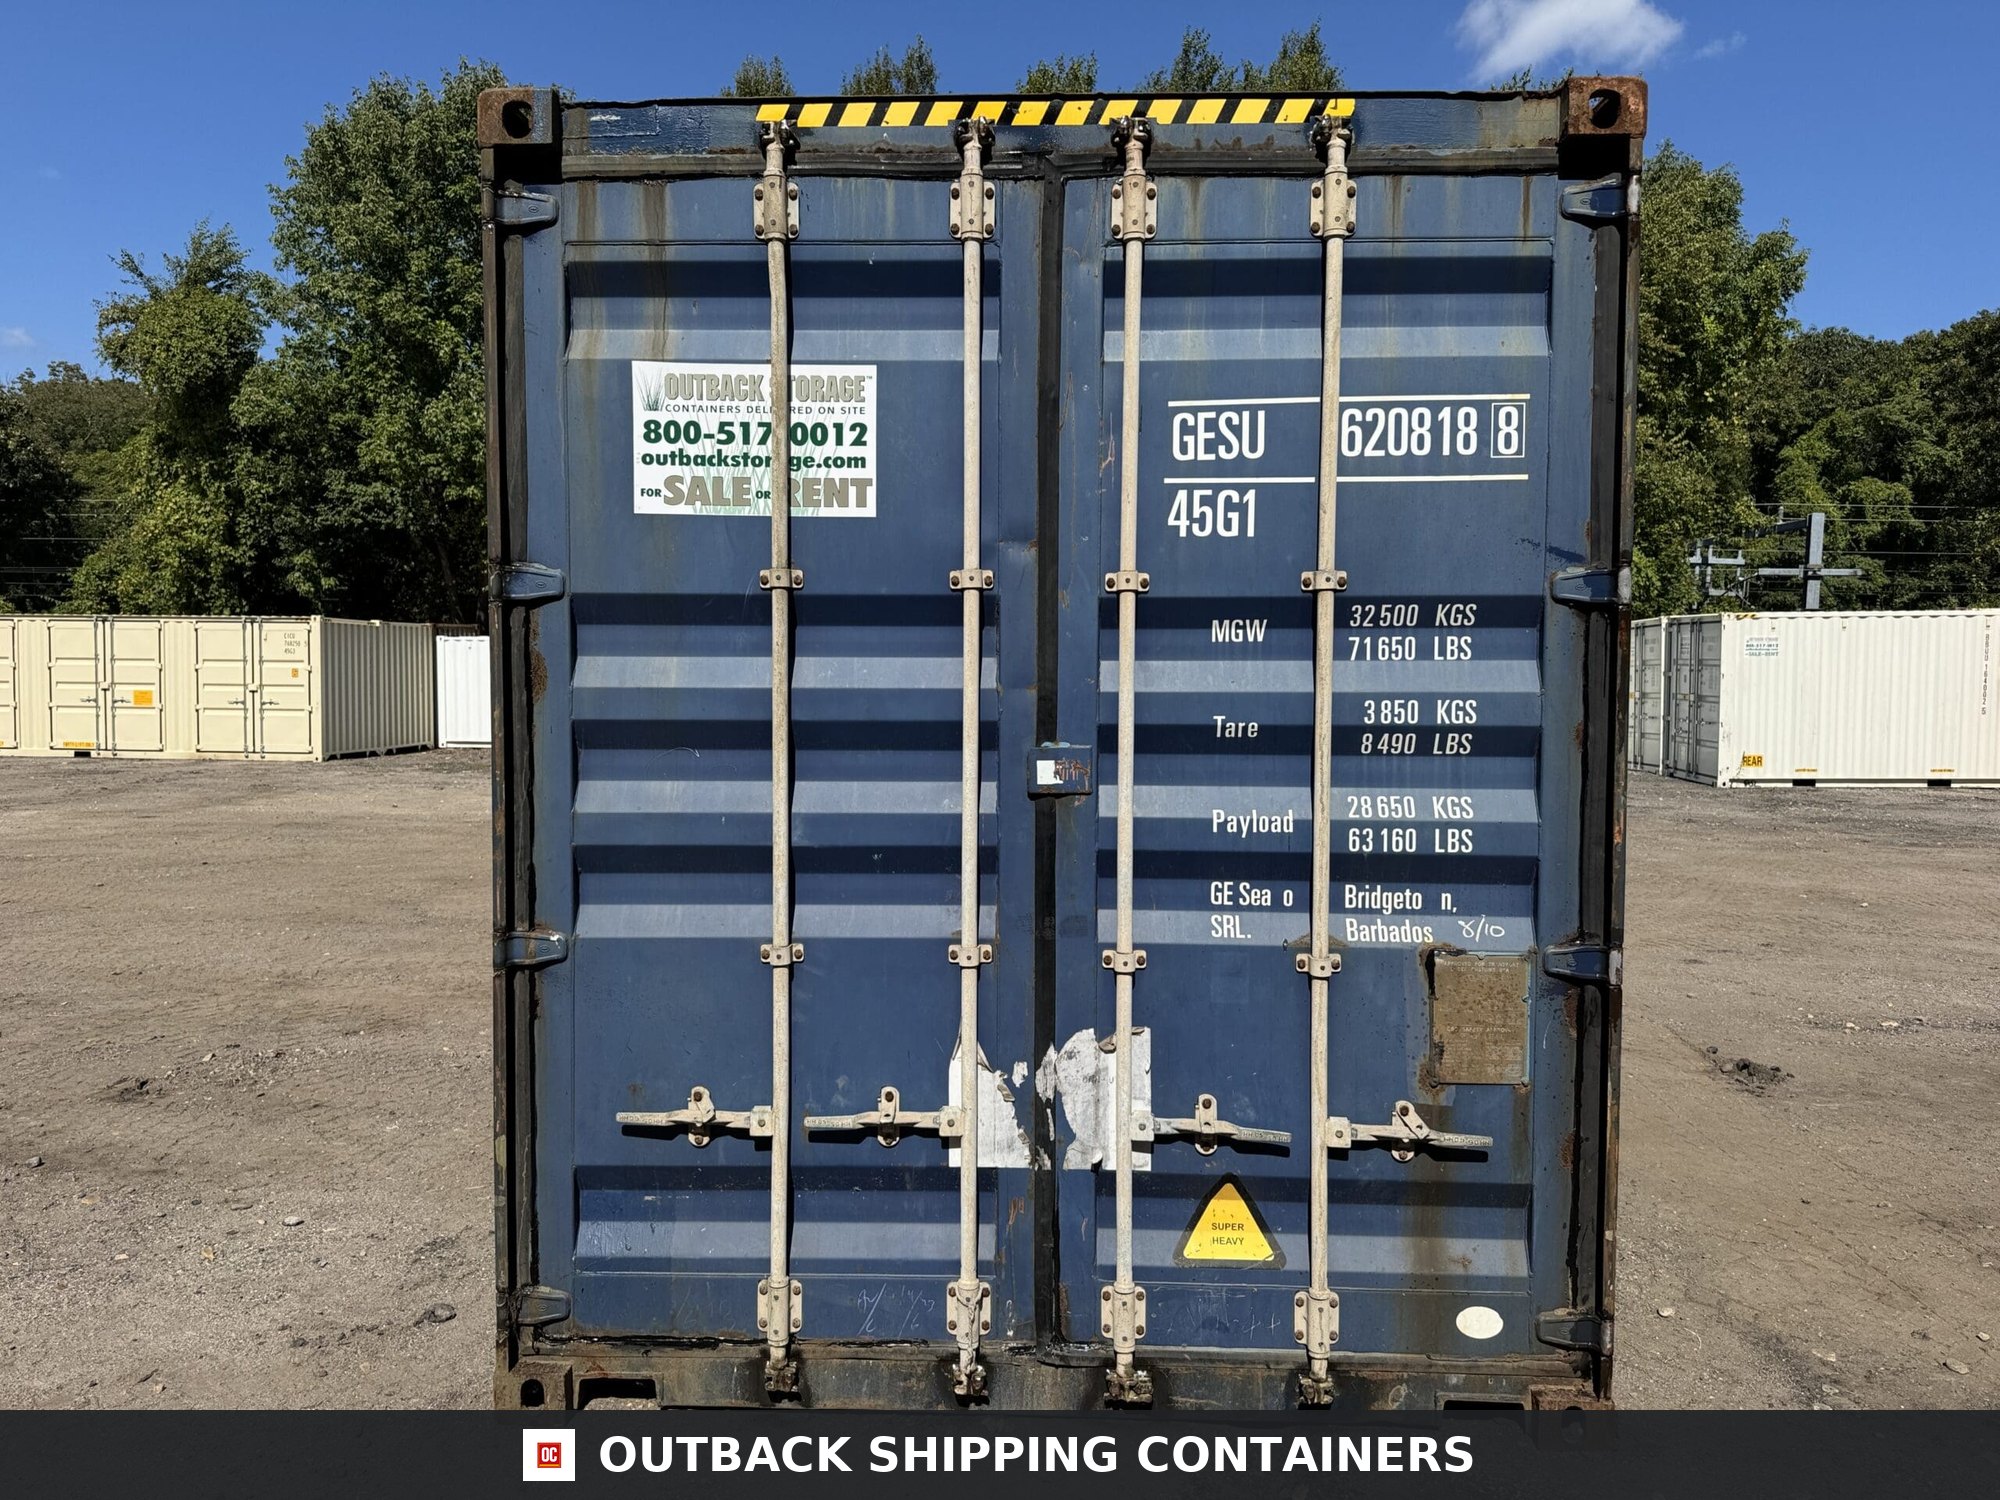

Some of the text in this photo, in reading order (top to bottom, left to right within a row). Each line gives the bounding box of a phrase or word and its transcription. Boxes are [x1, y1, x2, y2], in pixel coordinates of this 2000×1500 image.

[664, 373, 765, 402] OUTBACK
[769, 374, 866, 402] TORAGE
[665, 404, 866, 415] CONTAINERS DELIRED ON SITE
[643, 419, 868, 447] 800-5170012
[1171, 406, 1519, 461] GESU 620818 8
[641, 448, 866, 472] outbackstorge.com
[640, 488, 662, 498] FOR
[664, 475, 752, 507] SALE
[756, 491, 771, 500] OR
[1167, 489, 1257, 538] 45G1
[1435, 604, 1477, 627] KGS
[1211, 619, 1268, 643] MGW
[1433, 636, 1472, 661] LBS
[1436, 700, 1477, 724] KGS
[1213, 715, 1258, 738] Tare
[1432, 733, 1473, 755] LBS
[1743, 756, 1763, 767] REAR
[1432, 796, 1474, 819] KGS
[1212, 809, 1294, 839] Payload
[1434, 828, 1473, 853] LBS
[1210, 881, 1234, 906] GE
[1210, 914, 1252, 939] SRL.
[1345, 918, 1434, 943] Barbados
[1457, 914, 1506, 943] 8/10
[1211, 1223, 1245, 1231] SUPER
[1212, 1236, 1245, 1245] HEAVY
